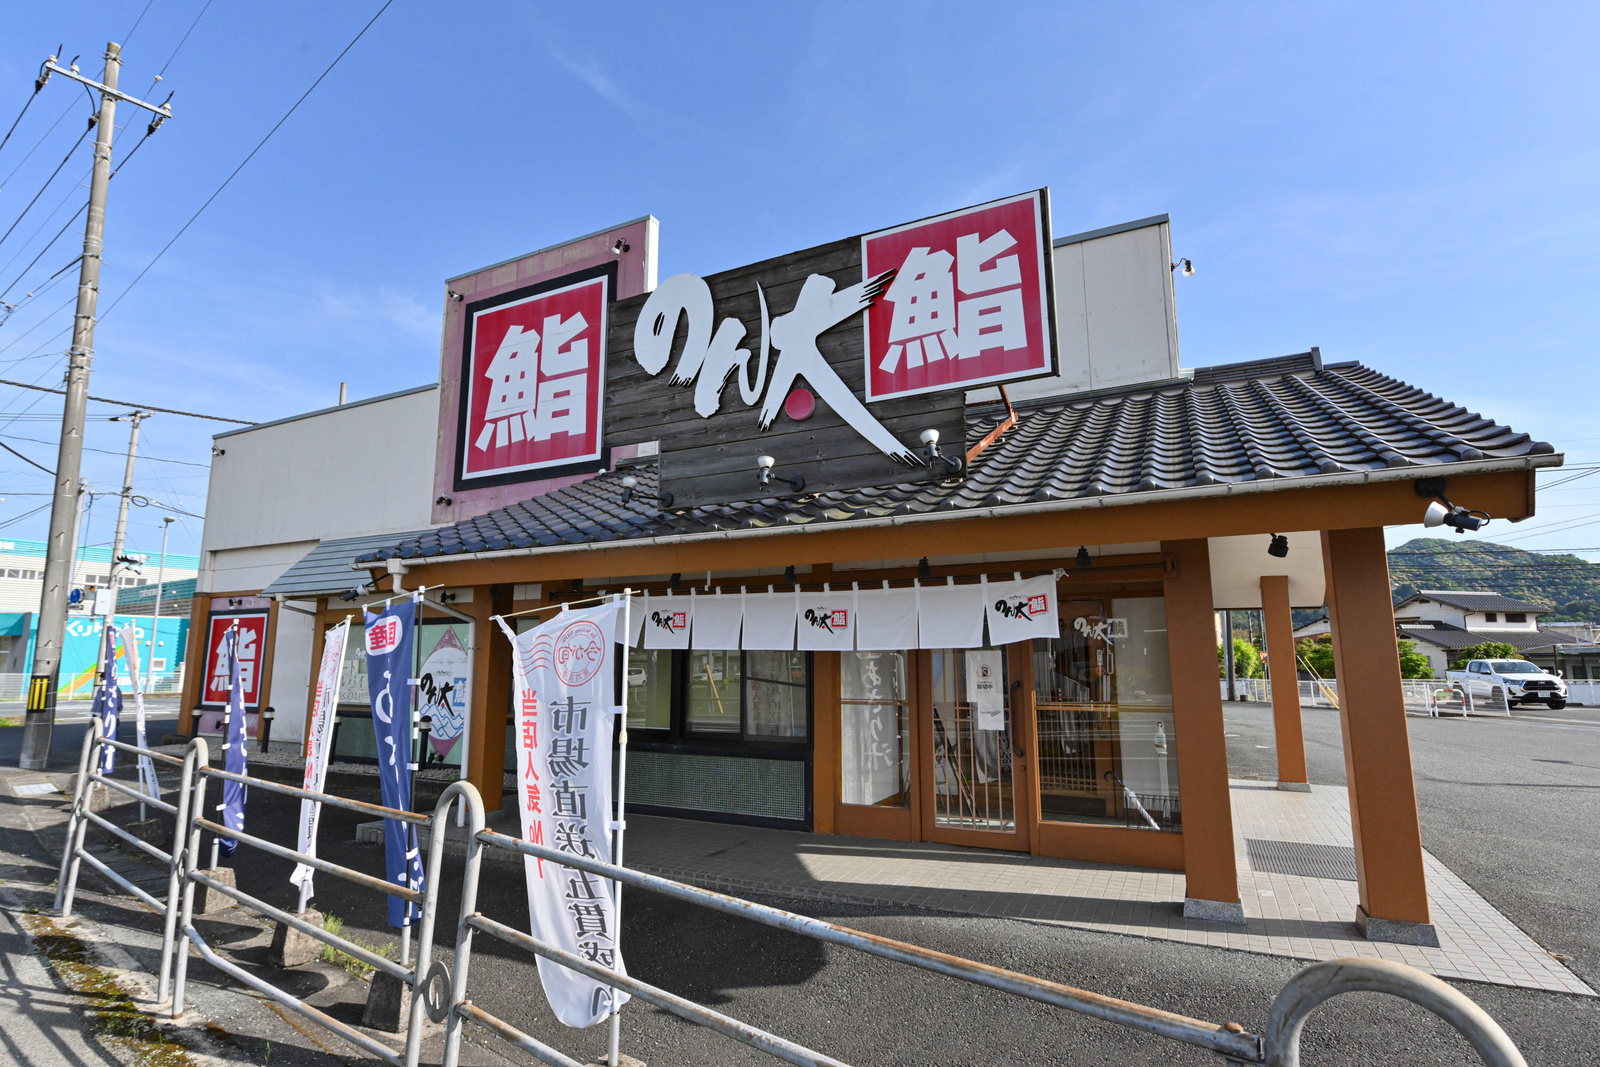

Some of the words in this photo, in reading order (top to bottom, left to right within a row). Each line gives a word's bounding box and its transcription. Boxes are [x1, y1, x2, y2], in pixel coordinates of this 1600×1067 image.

[474, 311, 589, 452] 鮨
[633, 269, 926, 467] のん太
[879, 228, 1028, 374] 鮨
